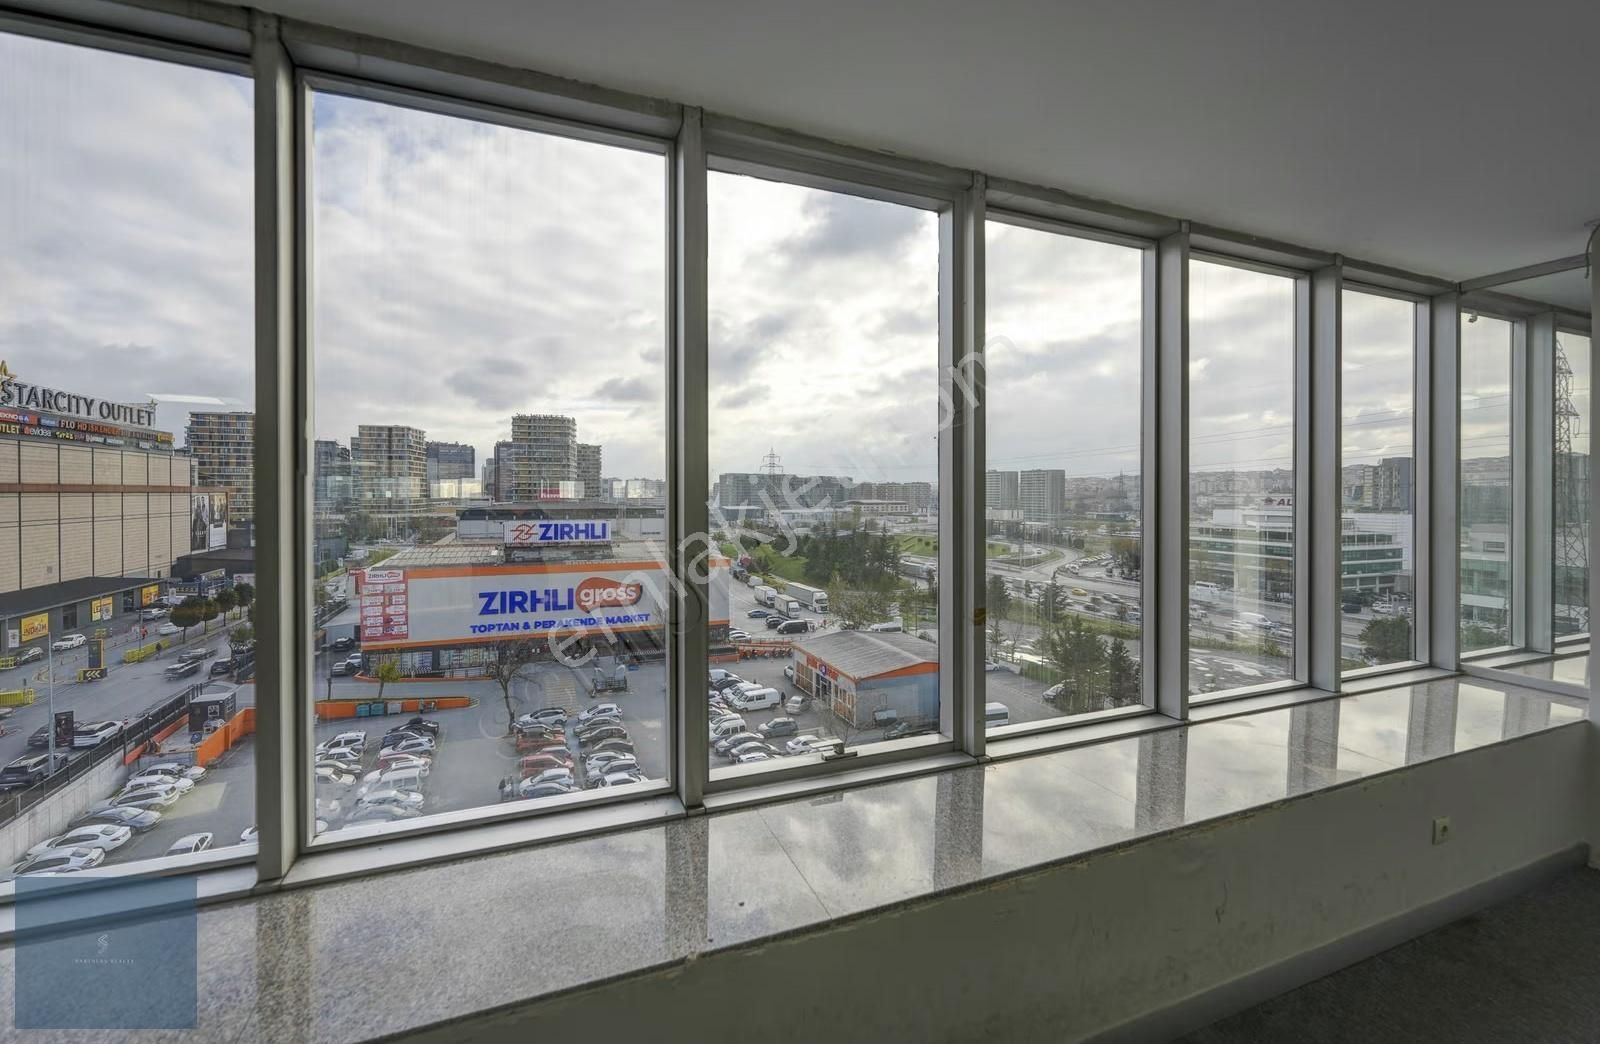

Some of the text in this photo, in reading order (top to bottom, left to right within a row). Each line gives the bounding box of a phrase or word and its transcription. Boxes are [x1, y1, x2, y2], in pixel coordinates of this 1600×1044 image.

[1, 380, 154, 426] STARCITY OUTLET
[0, 423, 20, 434] TLET
[60, 419, 75, 429] FLO
[539, 523, 607, 541] ZIRHLI
[478, 585, 637, 615] ZIRHLI gross
[470, 613, 650, 633] TOPTAN & PERAKENDE MARKET
